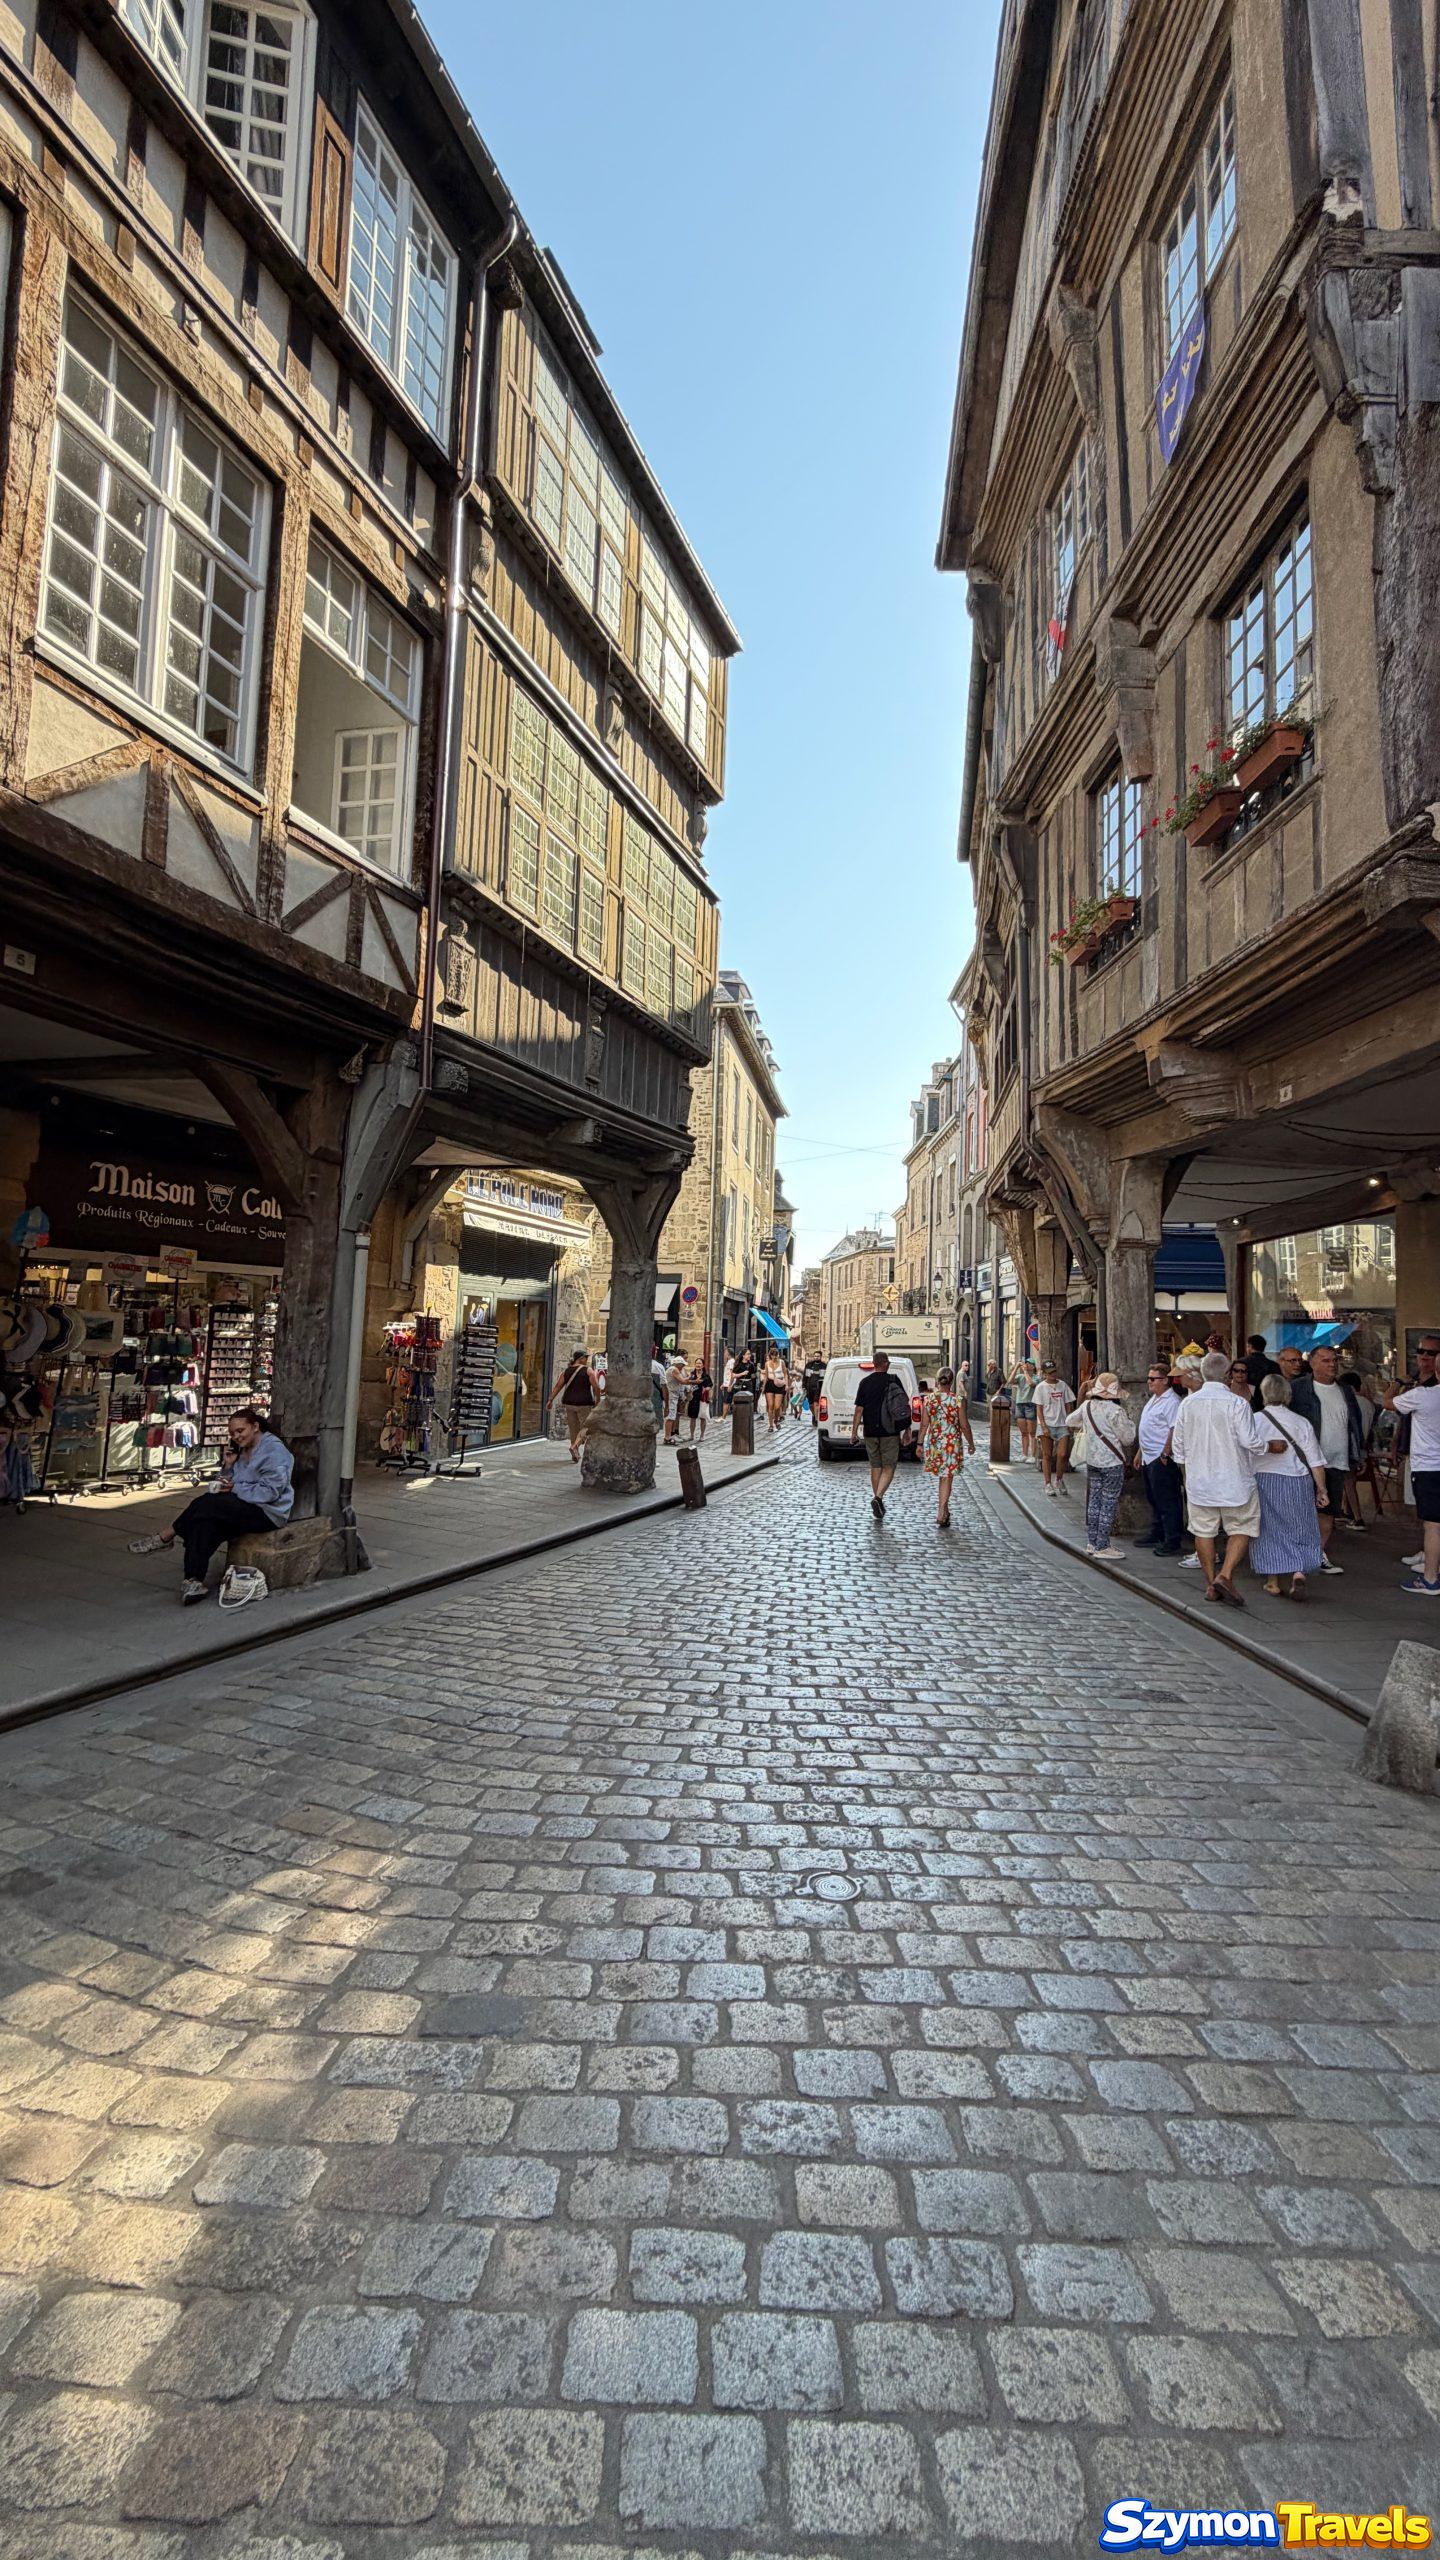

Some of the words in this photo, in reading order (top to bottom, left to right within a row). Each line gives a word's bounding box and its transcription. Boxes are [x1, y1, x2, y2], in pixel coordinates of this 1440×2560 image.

[88, 1161, 196, 1207] Maison
[76, 1202, 132, 1221] Produits
[135, 1208, 195, 1229] Régionaux
[205, 1219, 248, 1235] Cadeaux
